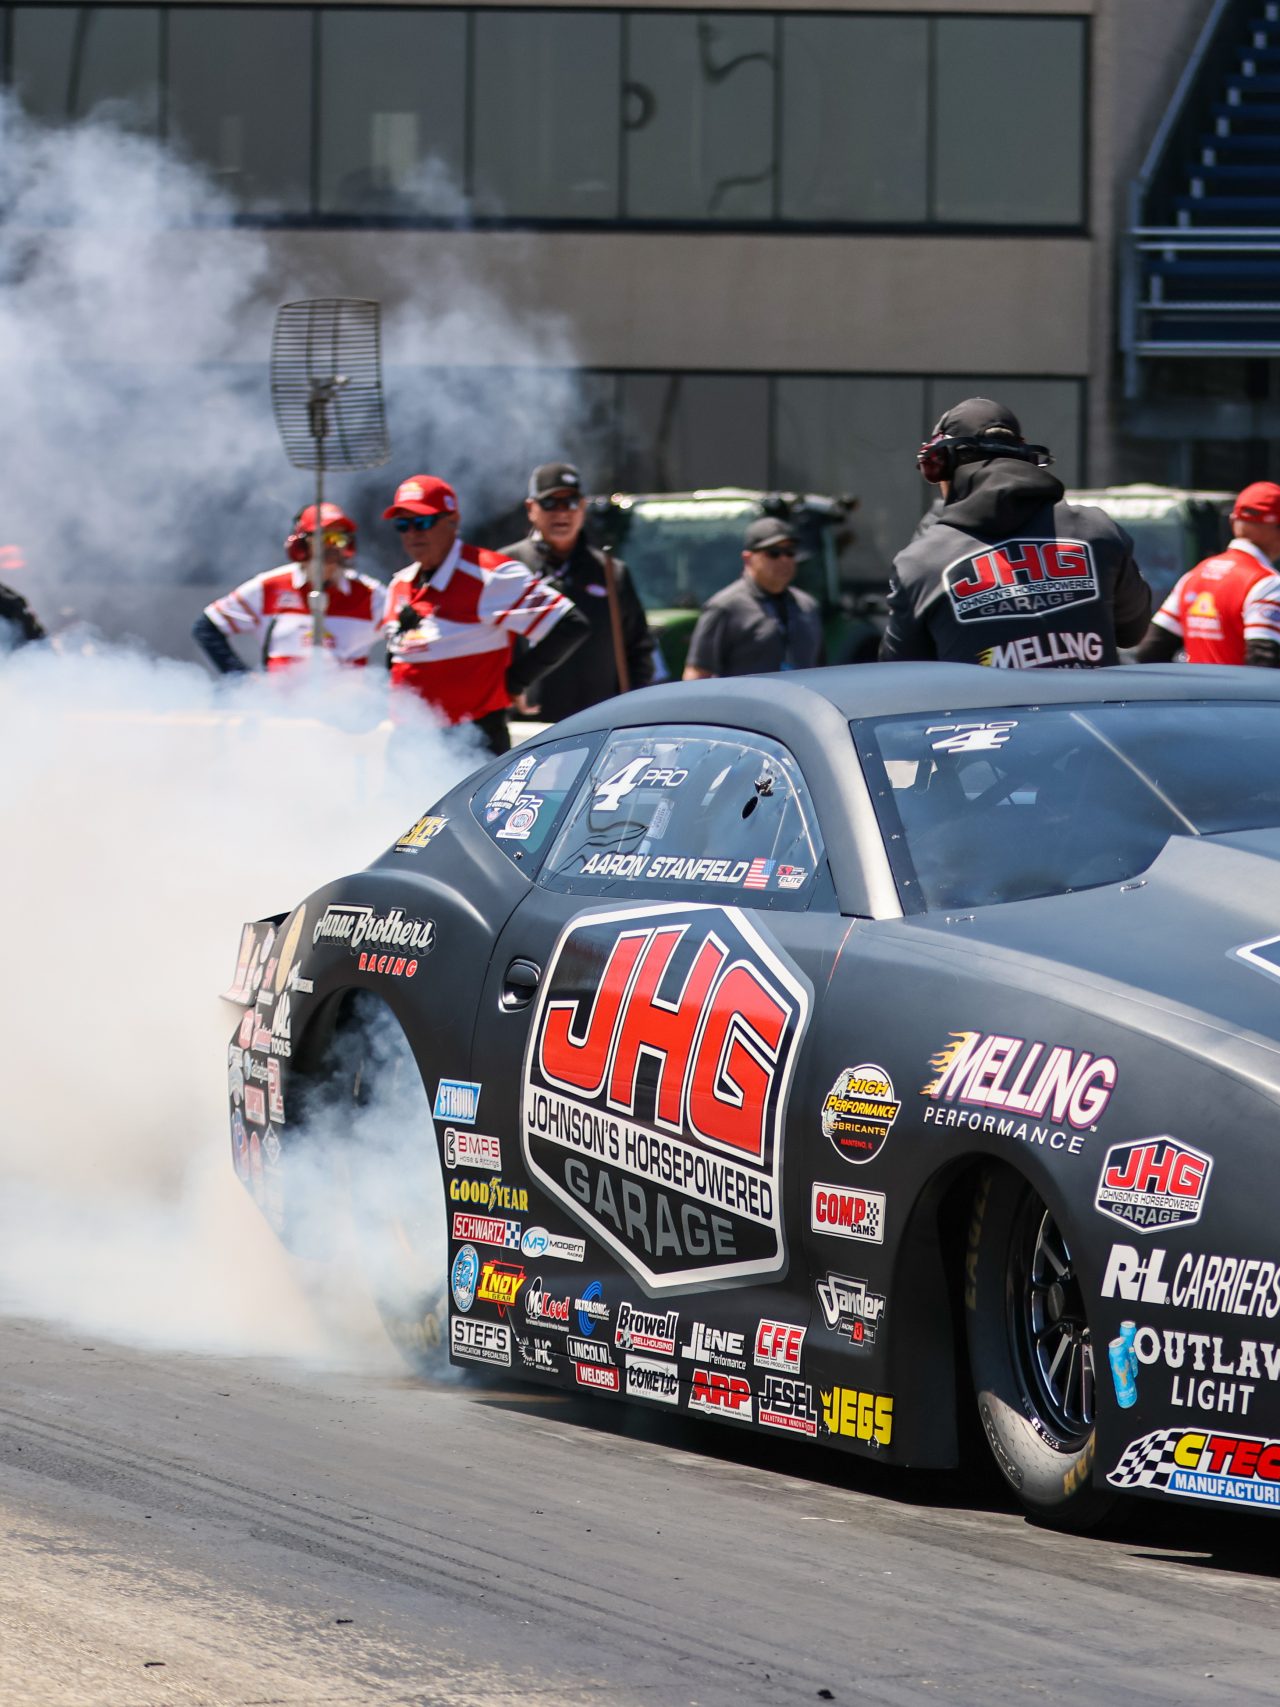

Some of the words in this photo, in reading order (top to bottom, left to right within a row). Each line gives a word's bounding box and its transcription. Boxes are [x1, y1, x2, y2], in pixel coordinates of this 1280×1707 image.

[952, 542, 1089, 599] JHG
[956, 588, 1012, 612] JOHNSON'S
[1014, 579, 1095, 596] HORSEPOWERED
[979, 592, 1075, 616] GARAGE
[988, 632, 1103, 669] MELLNG
[593, 757, 653, 811] 4
[637, 770, 689, 787] PRO
[580, 853, 649, 877] AARON
[648, 856, 750, 883] STANFIELD
[351, 905, 434, 948] Brothers
[359, 953, 418, 978] RACING
[539, 924, 793, 1166] JHG
[848, 1078, 890, 1097] HIGH
[930, 1031, 1118, 1130] MELLING
[439, 1086, 474, 1119] STROUD
[825, 1096, 896, 1119] PERFORMANCE
[923, 1107, 1085, 1156] PERFORMANCE
[528, 1094, 620, 1162] JOHNSON'S
[625, 1133, 773, 1222] HORSEPOWERED
[1105, 1143, 1206, 1199] JHG
[450, 1178, 529, 1212] GOODYEAR
[564, 1158, 737, 1257] GARAGE
[816, 1192, 866, 1227] COMP
[1098, 1190, 1139, 1204] JOHNSON'S
[1140, 1193, 1200, 1211] HORSEPOWERED
[851, 1223, 876, 1237] CAMS
[1110, 1203, 1181, 1225] GARAGE
[455, 1216, 505, 1246] SCHWARTZ
[527, 1290, 570, 1321] McLeod
[618, 1304, 677, 1340] Browell
[454, 1320, 507, 1350] STEF'S
[633, 1336, 672, 1351] BELLHOUSING
[757, 1324, 804, 1363] CFE
[454, 1343, 480, 1356] FABRICATION
[482, 1349, 508, 1362] SPECIALTIES
[569, 1341, 608, 1364] LINCOLN
[710, 1352, 746, 1370] Performance
[580, 1366, 615, 1387] WELDERS
[628, 1365, 679, 1396] COMETIC
[692, 1370, 751, 1410] ARP
[758, 1376, 816, 1422] JESEL
[1171, 1376, 1255, 1415] LIGHT
[822, 1386, 894, 1446] JEGS
